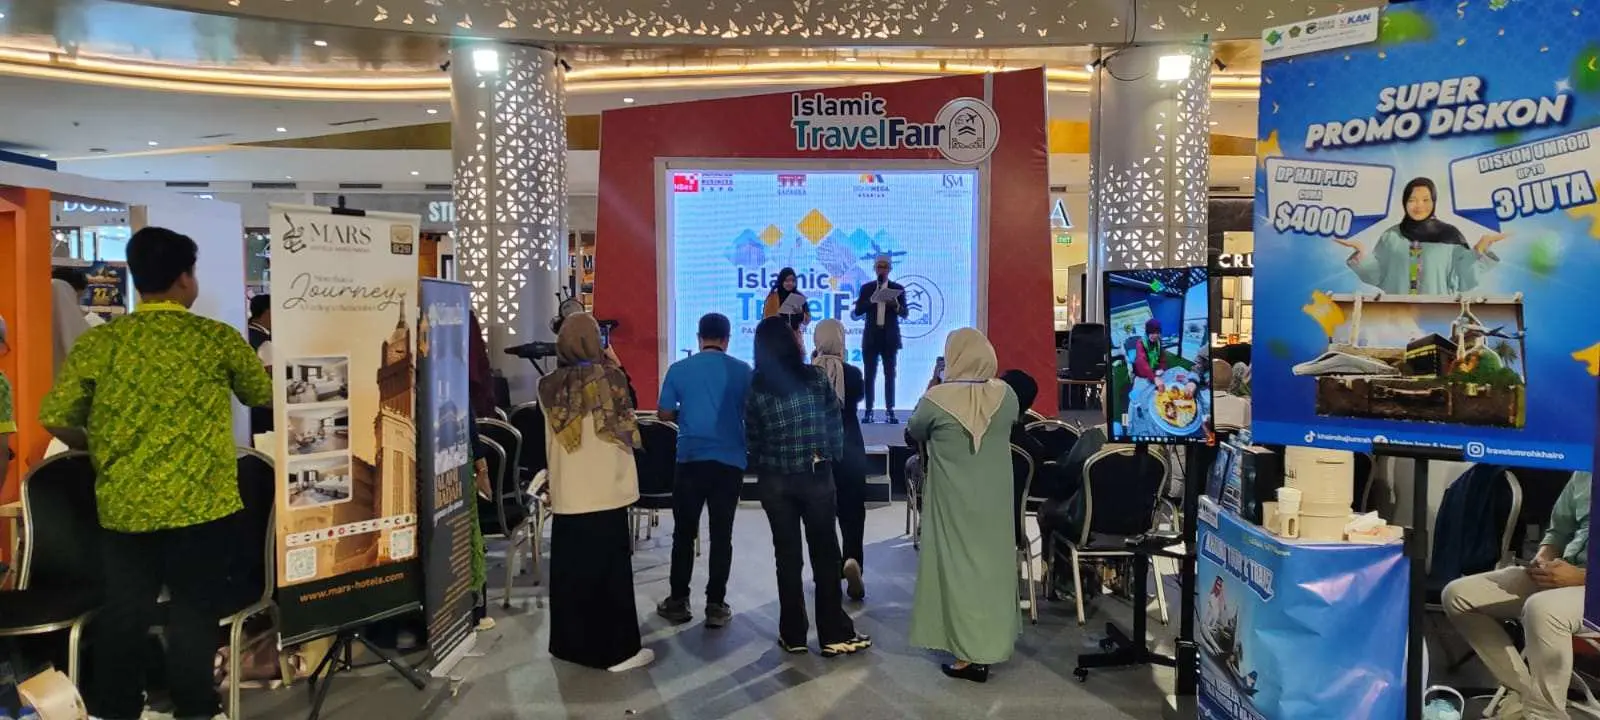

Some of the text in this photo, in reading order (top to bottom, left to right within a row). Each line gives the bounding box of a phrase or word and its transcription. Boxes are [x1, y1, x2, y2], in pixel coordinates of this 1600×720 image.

[1347, 13, 1371, 24] KAN
[793, 93, 886, 116] Islamic
[1376, 76, 1481, 113] SUPER
[1304, 94, 1568, 150] PROMO DISKON
[1478, 132, 1590, 173] DISKON UMROH
[1276, 166, 1358, 187] DP HAJI PLUS
[1516, 164, 1545, 179] UP TO
[1492, 170, 1596, 221] 3 JUTA
[310, 222, 372, 245] MARS
[1275, 202, 1353, 238] $4000
[283, 272, 399, 311] Journey
[299, 572, 404, 602] www.mars-hotels.com
